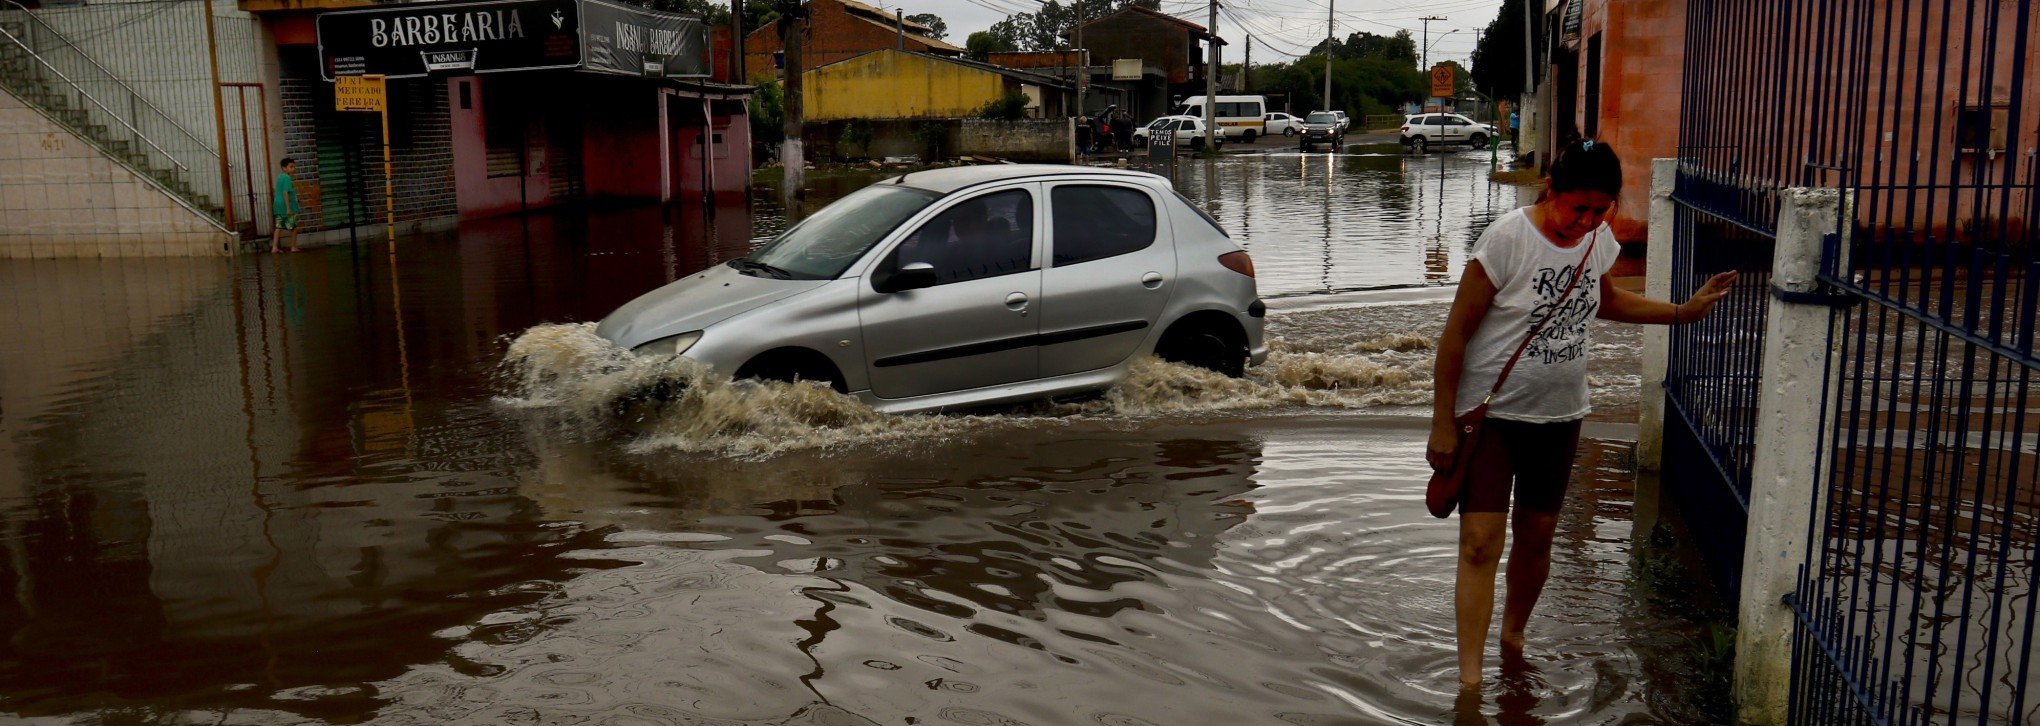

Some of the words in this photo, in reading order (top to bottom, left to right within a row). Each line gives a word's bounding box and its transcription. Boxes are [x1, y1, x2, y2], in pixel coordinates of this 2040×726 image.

[370, 9, 525, 48] BARBEARIA
[616, 21, 649, 53] INSANUS
[432, 53, 466, 63] INSANUS
[335, 77, 361, 85] MINI
[338, 86, 381, 95] MERCADO
[336, 97, 381, 106] PEREIRA
[1542, 338, 1586, 365] INSIDE
